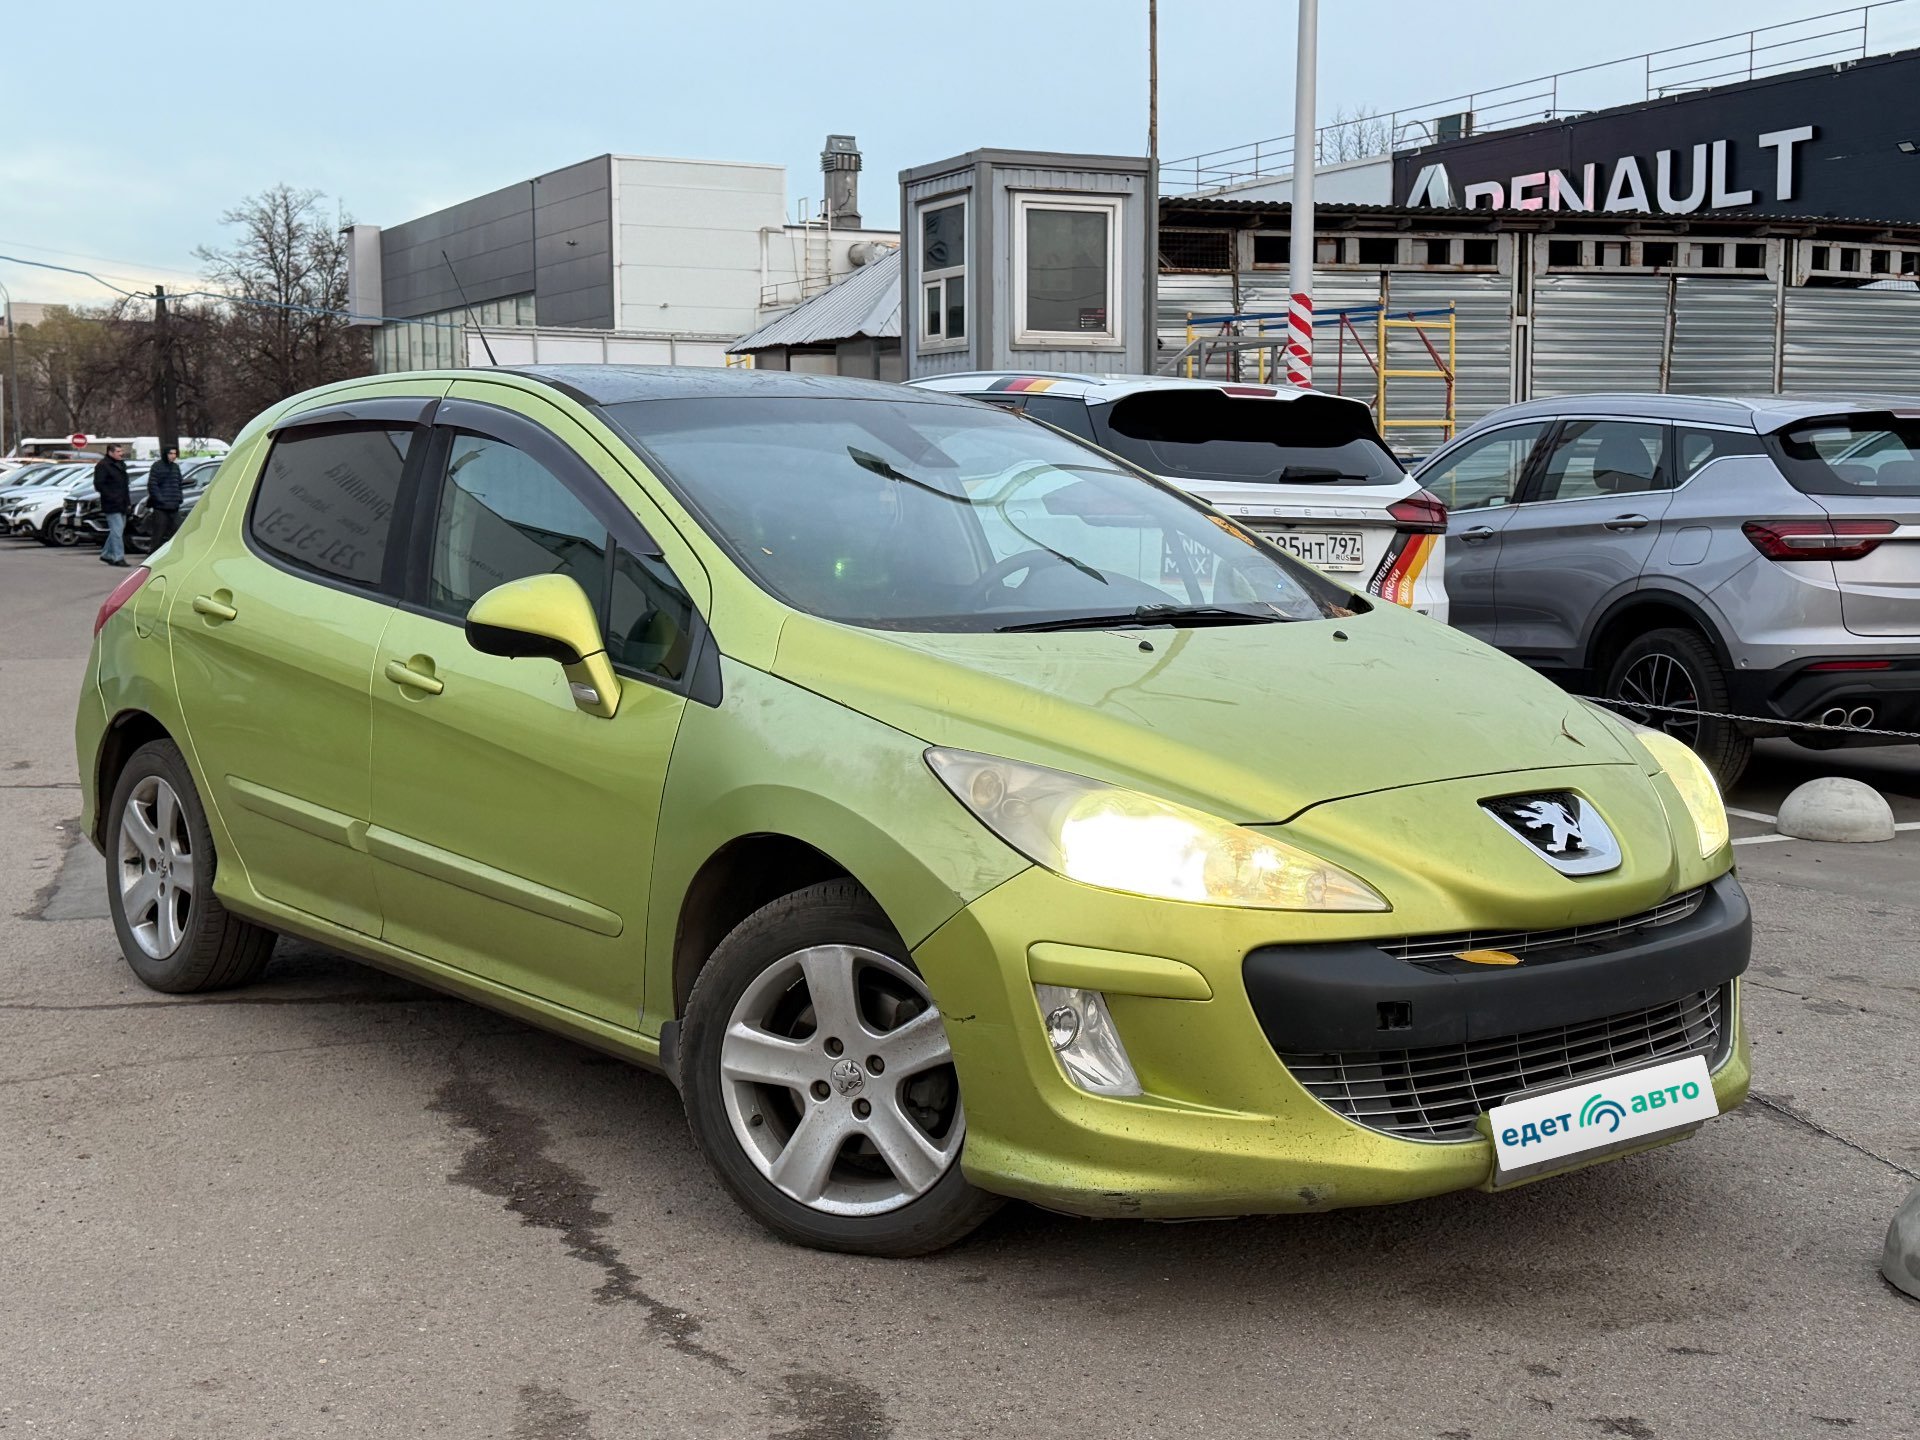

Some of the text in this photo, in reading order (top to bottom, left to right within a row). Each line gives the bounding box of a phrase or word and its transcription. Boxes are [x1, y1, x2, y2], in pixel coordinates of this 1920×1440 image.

[1240, 506, 1368, 518] GEELY
[1265, 535, 1357, 559] 85НТ 797
[1164, 557, 1207, 574] MX
